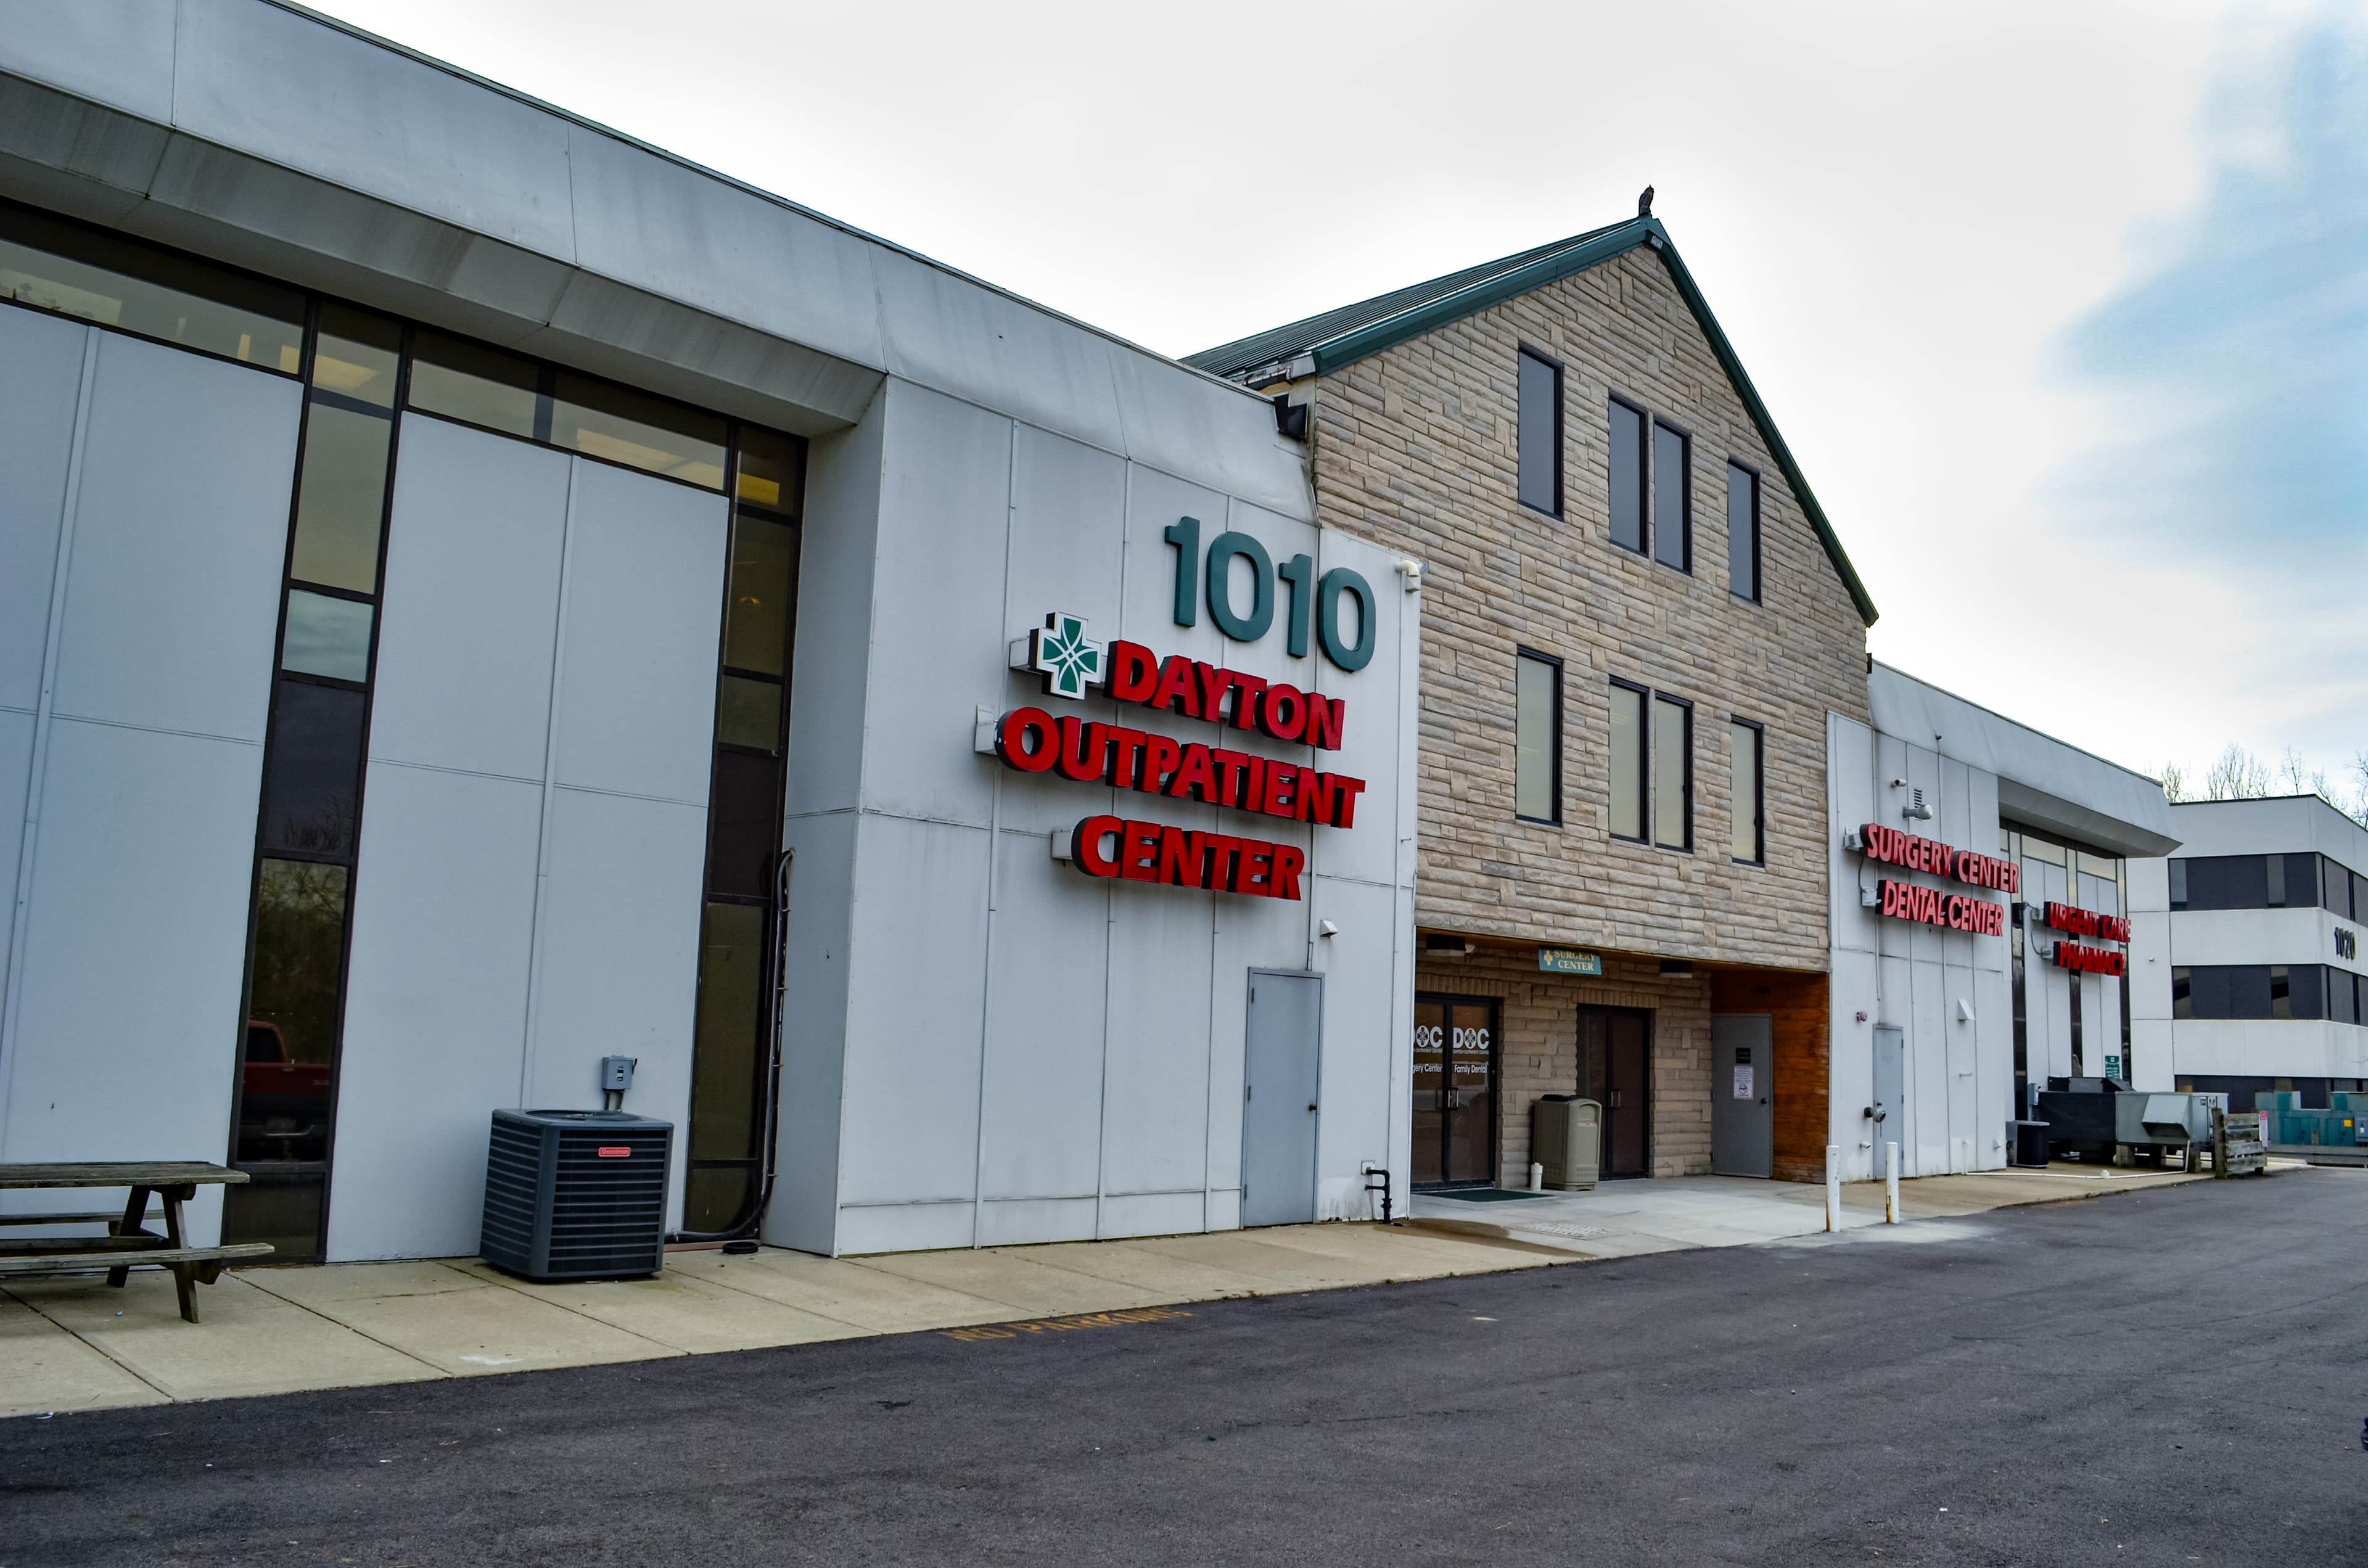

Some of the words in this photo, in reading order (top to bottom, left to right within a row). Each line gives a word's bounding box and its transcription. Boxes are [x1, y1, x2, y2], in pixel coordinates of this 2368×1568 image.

[1165, 516, 1376, 671] 1010
[1108, 639, 1345, 750] DAYTON
[997, 707, 1365, 829] OUTPATIENT
[1072, 815, 1305, 900] CENTER
[1864, 823, 1954, 877] SURGERY
[1956, 850, 2019, 893] CENTER
[1881, 879, 1946, 925] DENTAL
[1947, 895, 2004, 937] CENTER
[2049, 901, 2100, 937] URGENT
[2102, 915, 2131, 943] CARE
[1555, 950, 1595, 961] SURGERY
[1558, 959, 1594, 971] CENTER
[2058, 941, 2126, 977] PHARMACY
[1453, 1027, 1489, 1049] DOC
[1424, 1064, 1442, 1072] Center
[1454, 1064, 1470, 1075] Family
[1471, 1065, 1487, 1073] Dental
